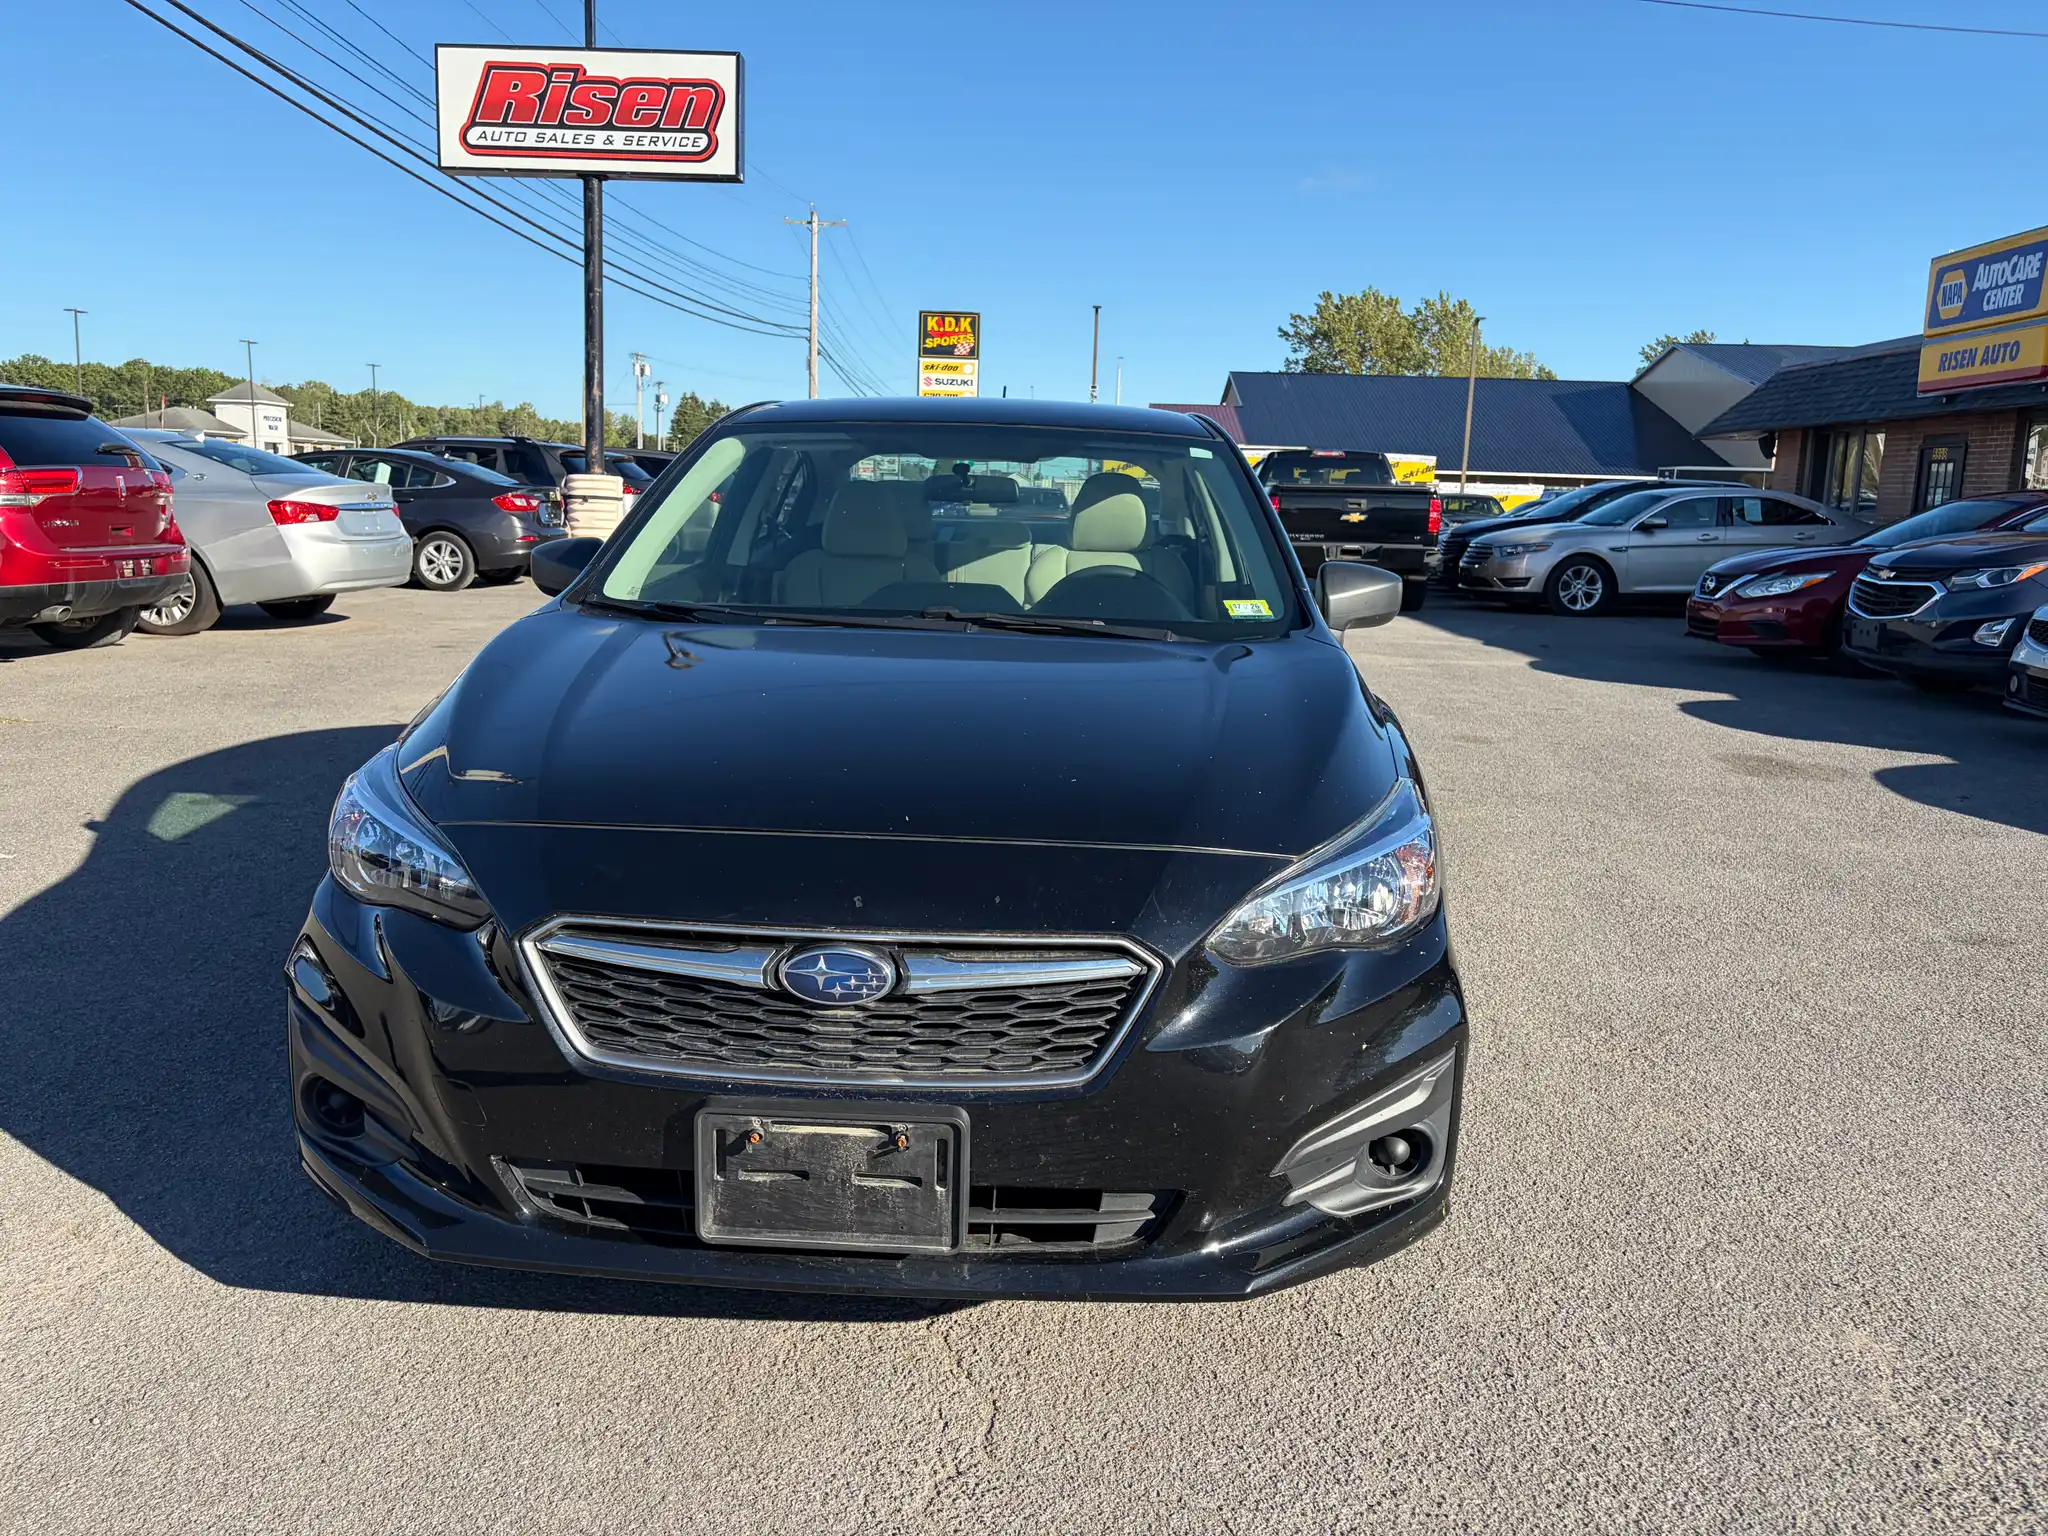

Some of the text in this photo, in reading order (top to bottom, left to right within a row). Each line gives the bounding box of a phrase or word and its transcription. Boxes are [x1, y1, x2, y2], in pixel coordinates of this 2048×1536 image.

[476, 69, 715, 128] Risen
[476, 130, 704, 148] AUTO SALES & SERVICE
[1940, 280, 1963, 308] NAPA
[1982, 283, 2024, 311] CENTER
[925, 333, 975, 348] SPORTS
[1937, 340, 2021, 372] RISEN AUTO
[934, 378, 974, 386] SUZUKI
